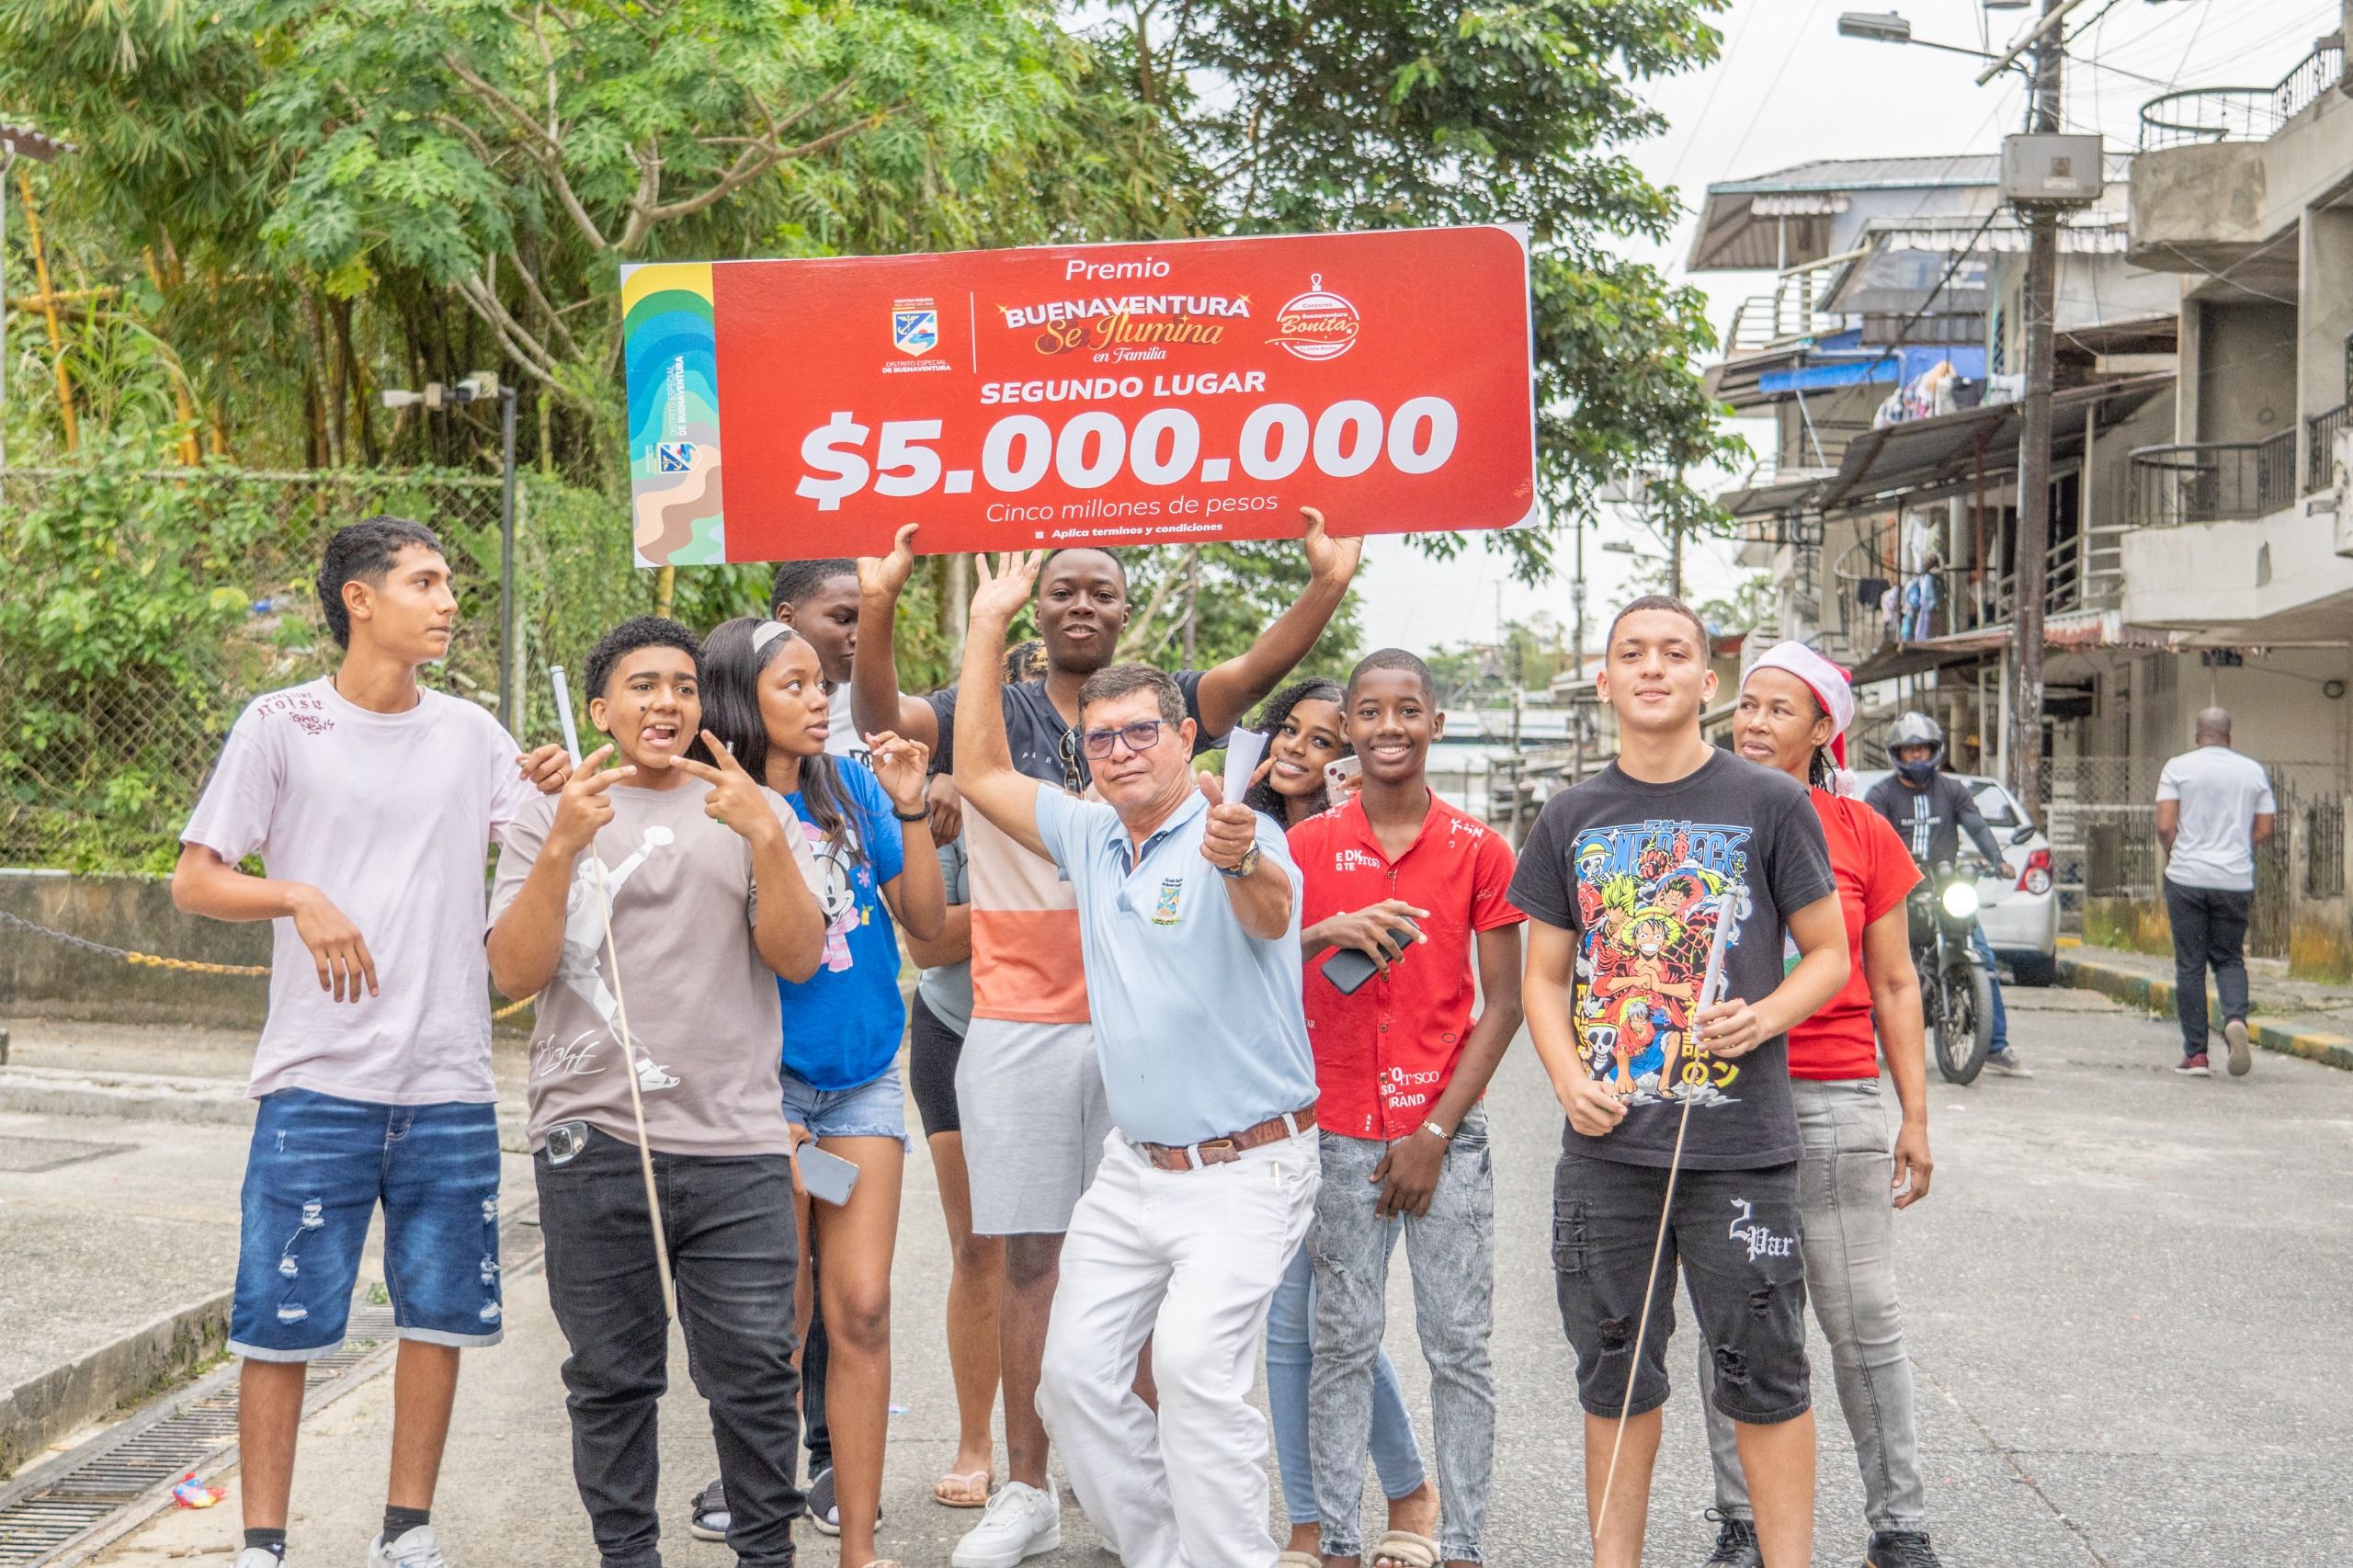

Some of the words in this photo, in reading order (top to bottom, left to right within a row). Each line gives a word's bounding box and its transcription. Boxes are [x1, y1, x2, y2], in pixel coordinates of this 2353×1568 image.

[1066, 257, 1170, 281] Premio
[1005, 296, 1250, 328] BUENAVENTURA
[1035, 318, 1082, 355] Se
[1088, 312, 1224, 351] Ilumina
[1279, 314, 1347, 335] Bonita
[1094, 351, 1109, 363] en
[1111, 347, 1167, 364] Familia
[893, 365, 952, 373] BUENAVENTURA
[675, 356, 687, 423] BUENAVENTURA
[980, 377, 1144, 406] SEGUNDO
[1153, 371, 1267, 398] LUGAR
[678, 425, 687, 437] DE
[795, 397, 1459, 512] $5.000.000
[986, 503, 1054, 523] Cinco
[1061, 498, 1162, 519] millones
[1168, 494, 1199, 515] de
[1205, 495, 1279, 517] pesos
[1051, 527, 1090, 540] Aplica
[1091, 524, 1144, 536] terminos
[1145, 527, 1154, 535] y
[1154, 522, 1223, 533] condiciones
[1022, 752, 1064, 768] PARI
[1574, 831, 1652, 881] ONE
[1389, 1094, 1426, 1109] RAND
